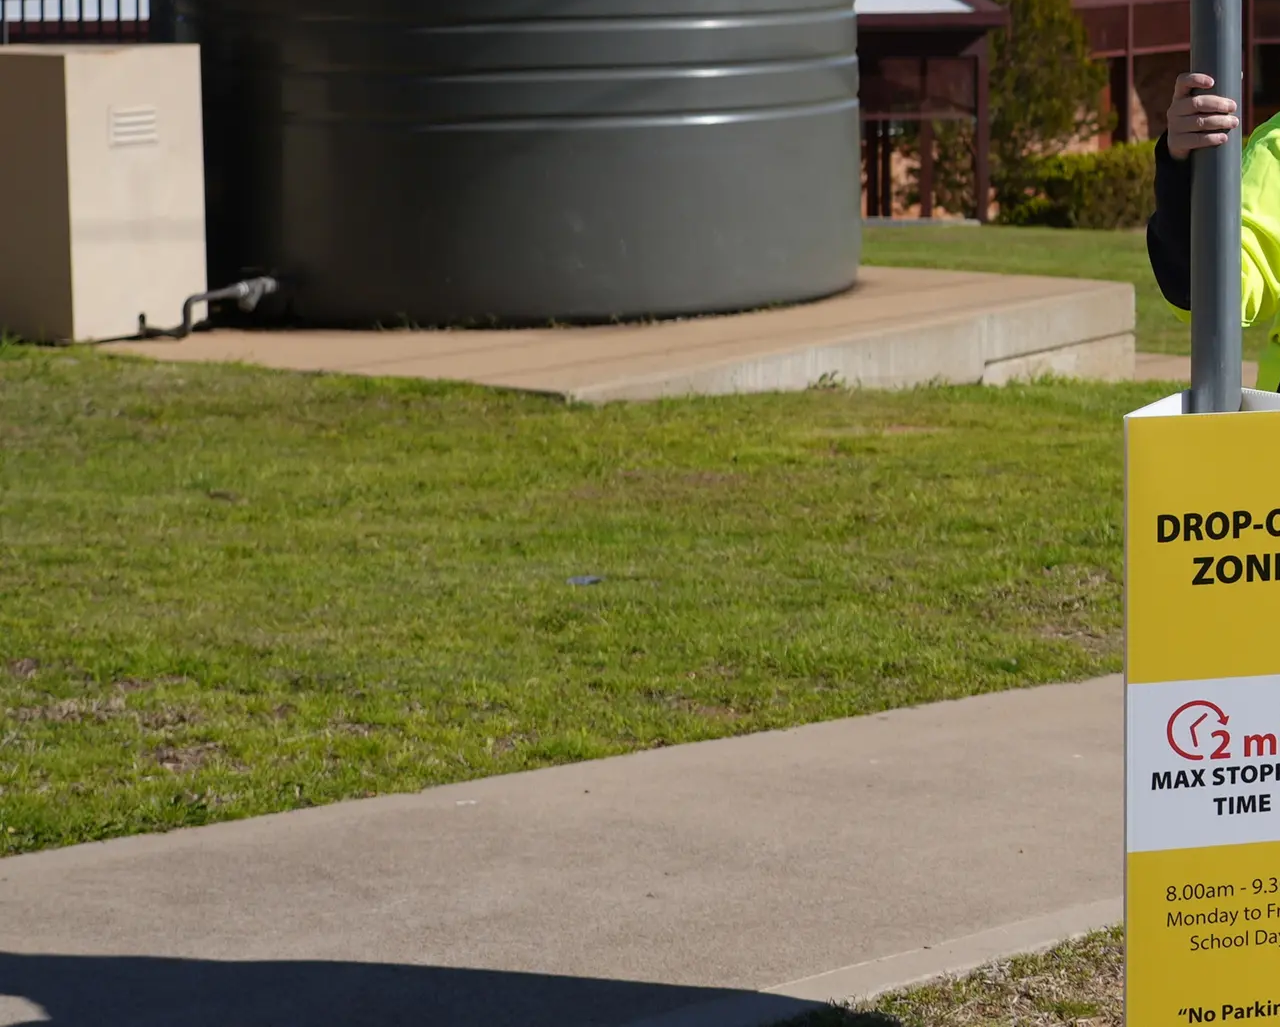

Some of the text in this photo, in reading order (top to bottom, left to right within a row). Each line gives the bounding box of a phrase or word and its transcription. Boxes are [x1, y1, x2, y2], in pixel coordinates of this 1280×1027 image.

[1210, 729, 1231, 759] 2
[1151, 769, 1206, 790] MAX
[1213, 794, 1271, 815] TIME
[1166, 883, 1234, 901] 8.00am
[1167, 908, 1239, 927] Monday
[1244, 907, 1261, 921] to
[1190, 930, 1249, 951] School
[1178, 1007, 1216, 1023] “No
